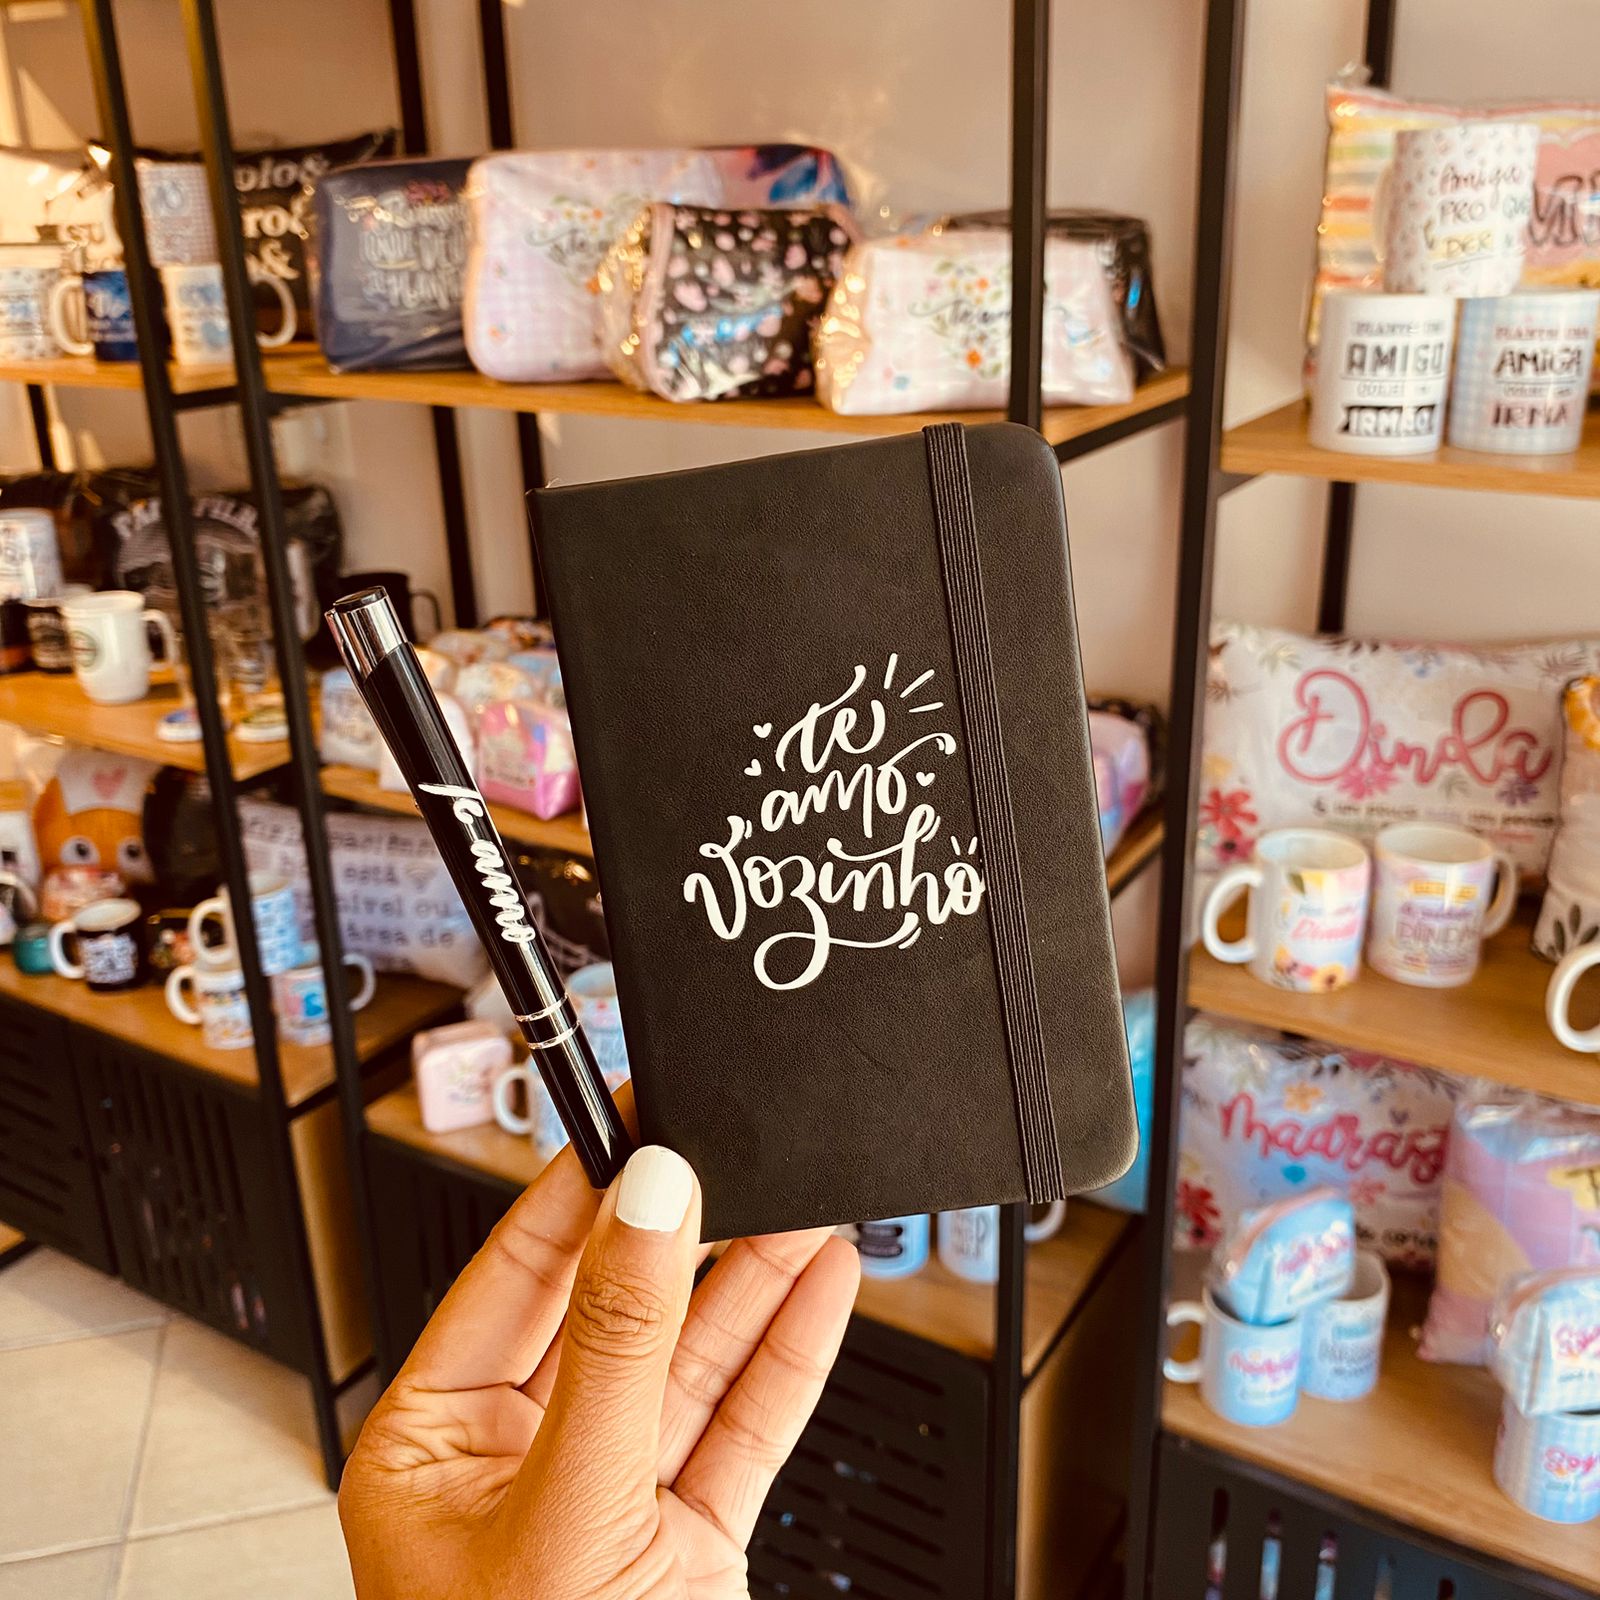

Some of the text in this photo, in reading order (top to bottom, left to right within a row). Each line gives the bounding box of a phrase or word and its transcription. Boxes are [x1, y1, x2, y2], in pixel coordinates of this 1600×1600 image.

[1348, 342, 1445, 376] AMIGO
[1494, 346, 1583, 377] AMIGA
[1278, 667, 1553, 786] Dinda
[761, 732, 957, 838] amo
